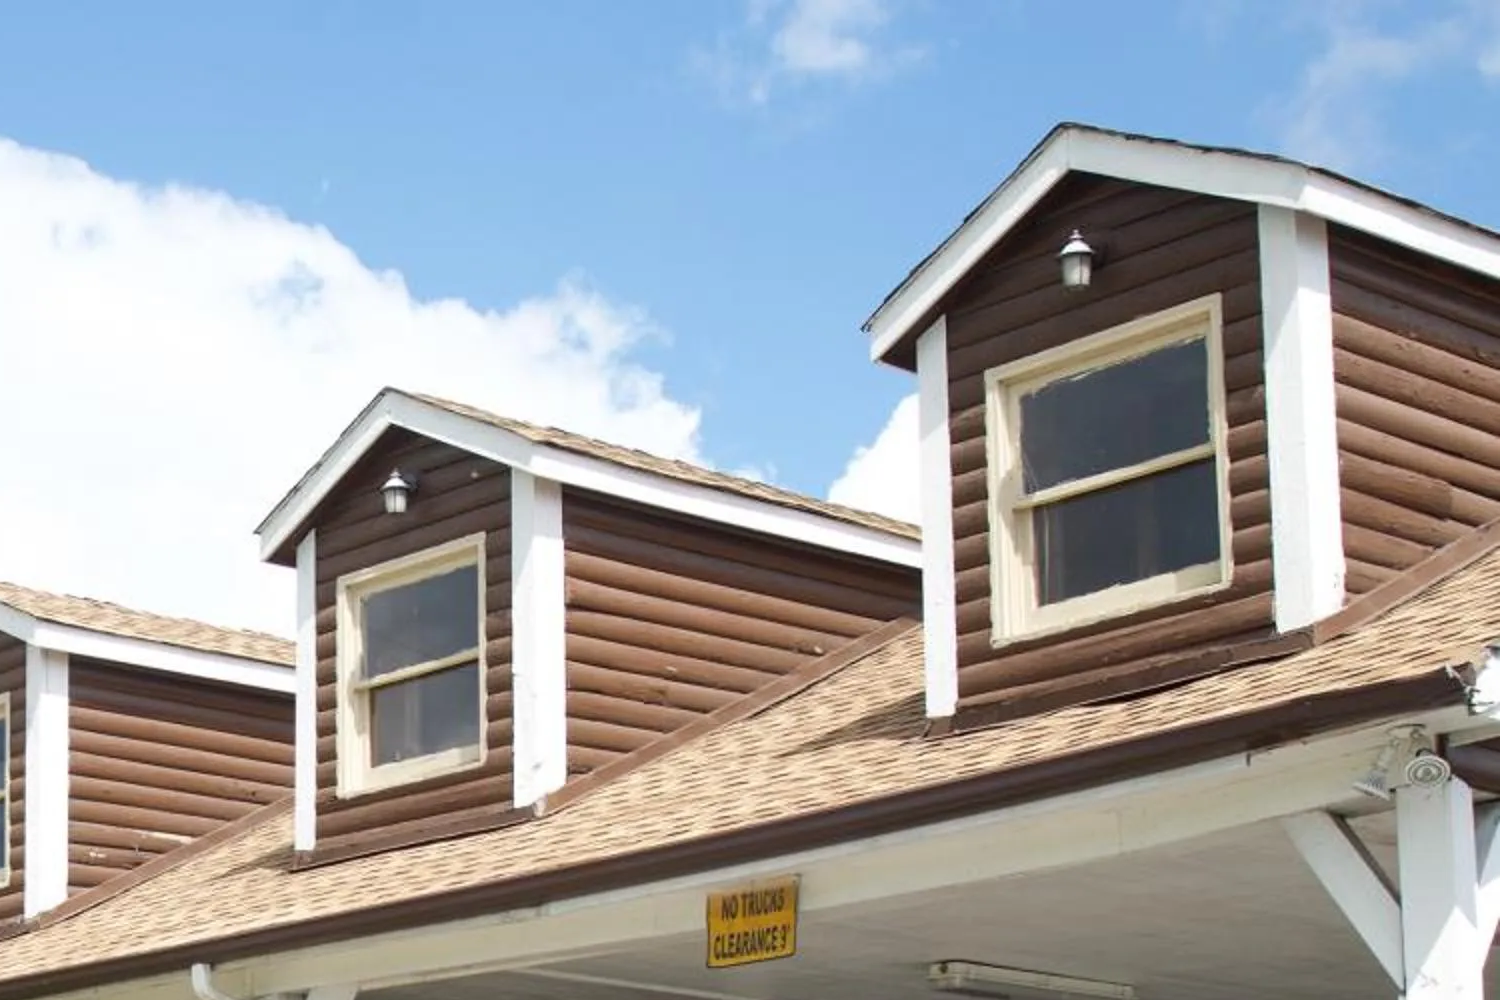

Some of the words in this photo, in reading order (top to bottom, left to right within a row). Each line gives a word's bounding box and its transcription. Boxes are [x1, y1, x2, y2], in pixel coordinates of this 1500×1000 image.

[720, 893, 739, 921] NO
[741, 886, 785, 918] TRUCKS
[713, 926, 778, 960] CLEARANCE
